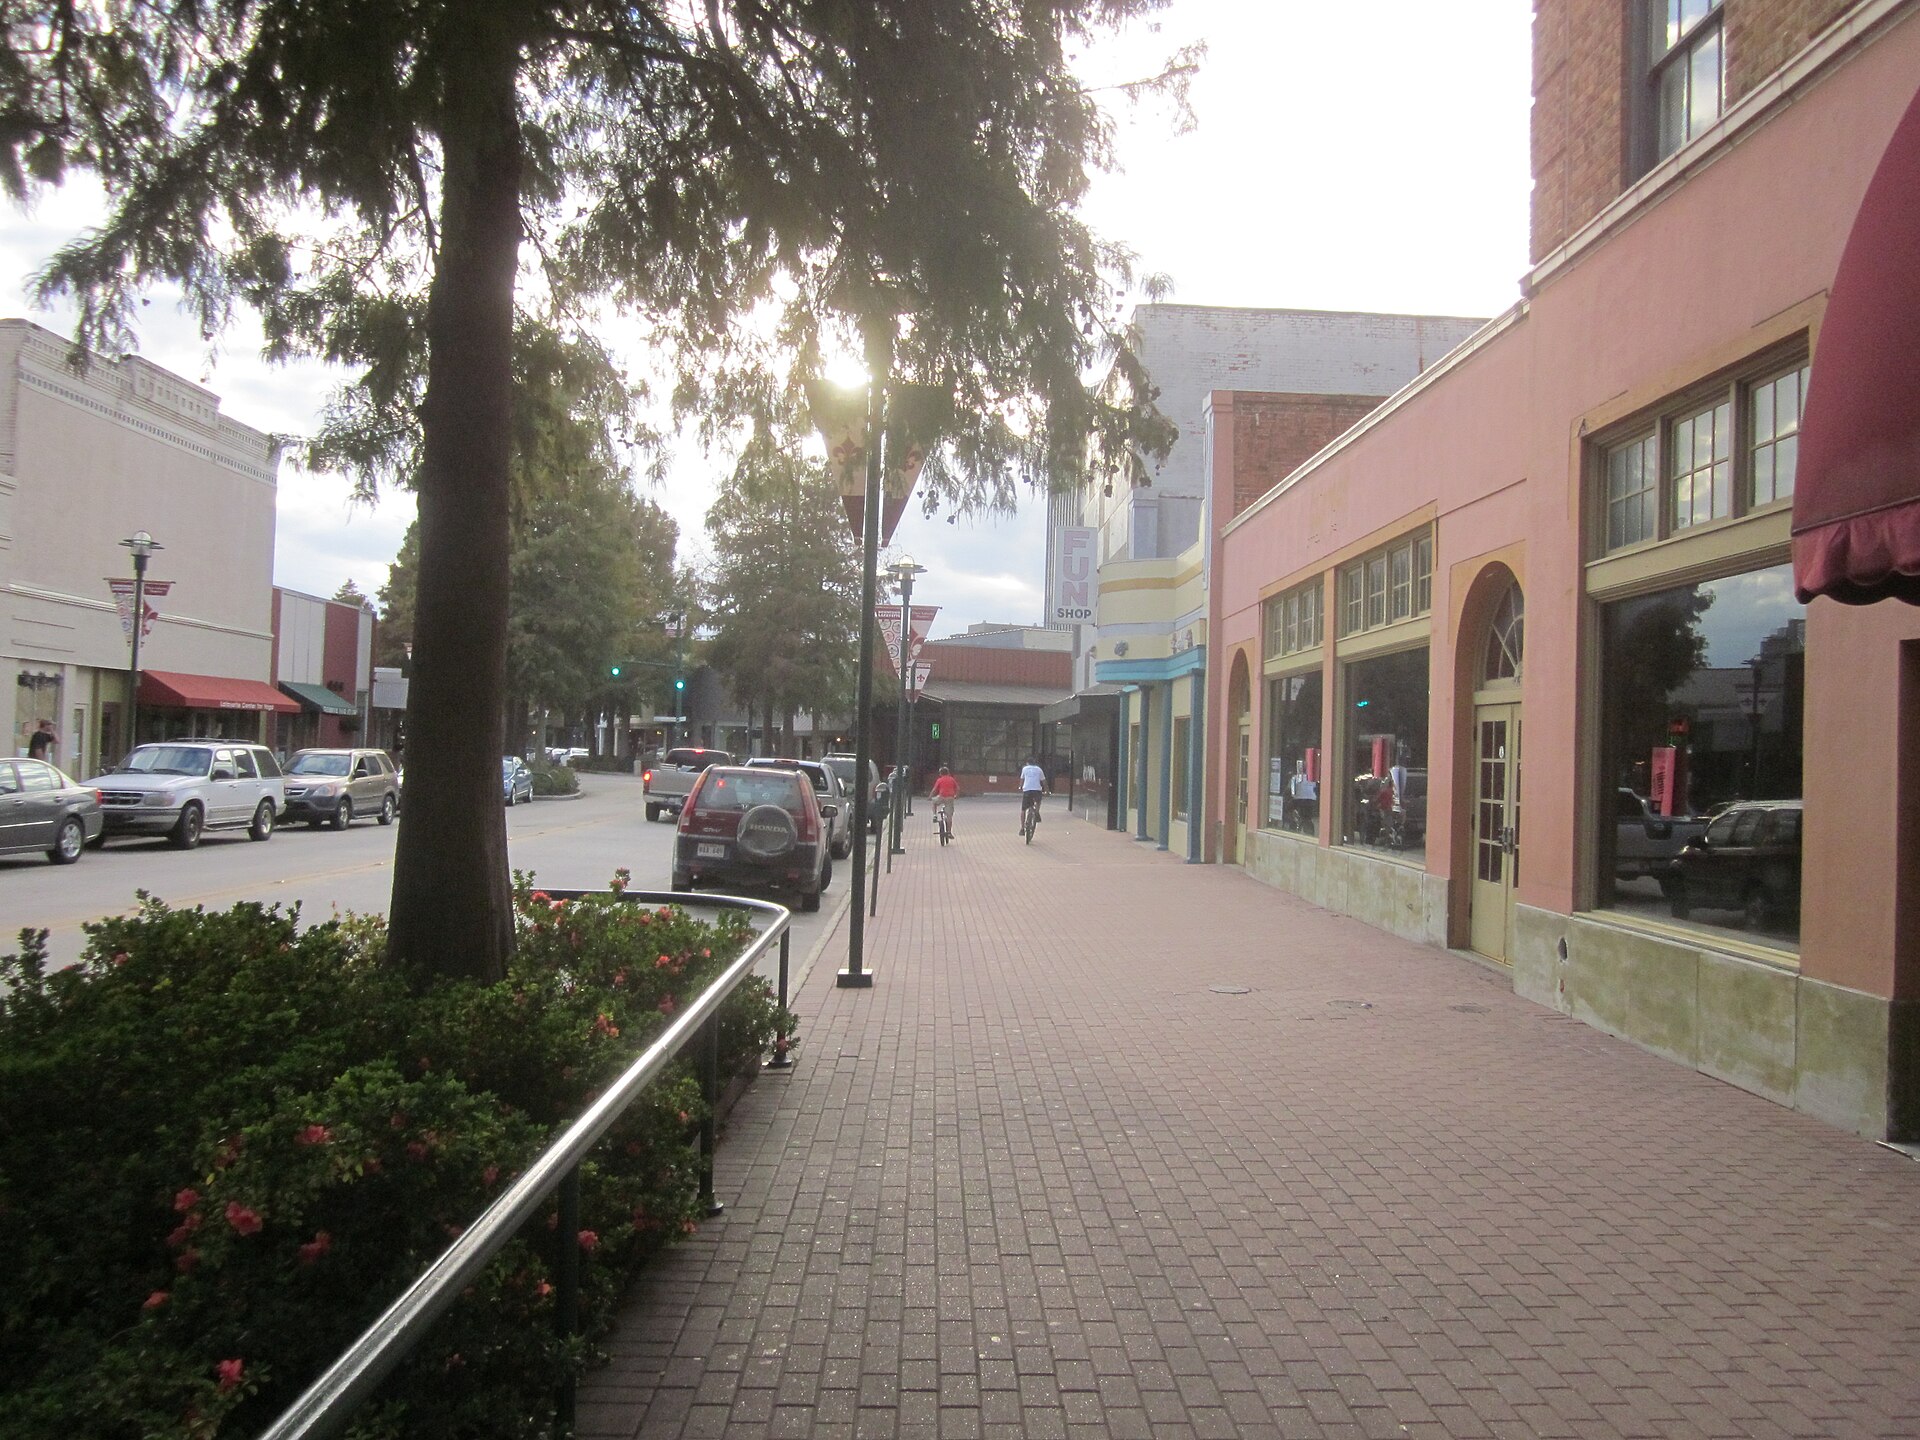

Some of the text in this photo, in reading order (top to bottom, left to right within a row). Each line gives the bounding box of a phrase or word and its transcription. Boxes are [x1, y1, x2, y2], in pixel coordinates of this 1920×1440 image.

[1062, 531, 1090, 606] FUN
[1057, 608, 1092, 619] SHOP
[749, 824, 788, 833] HONDA
